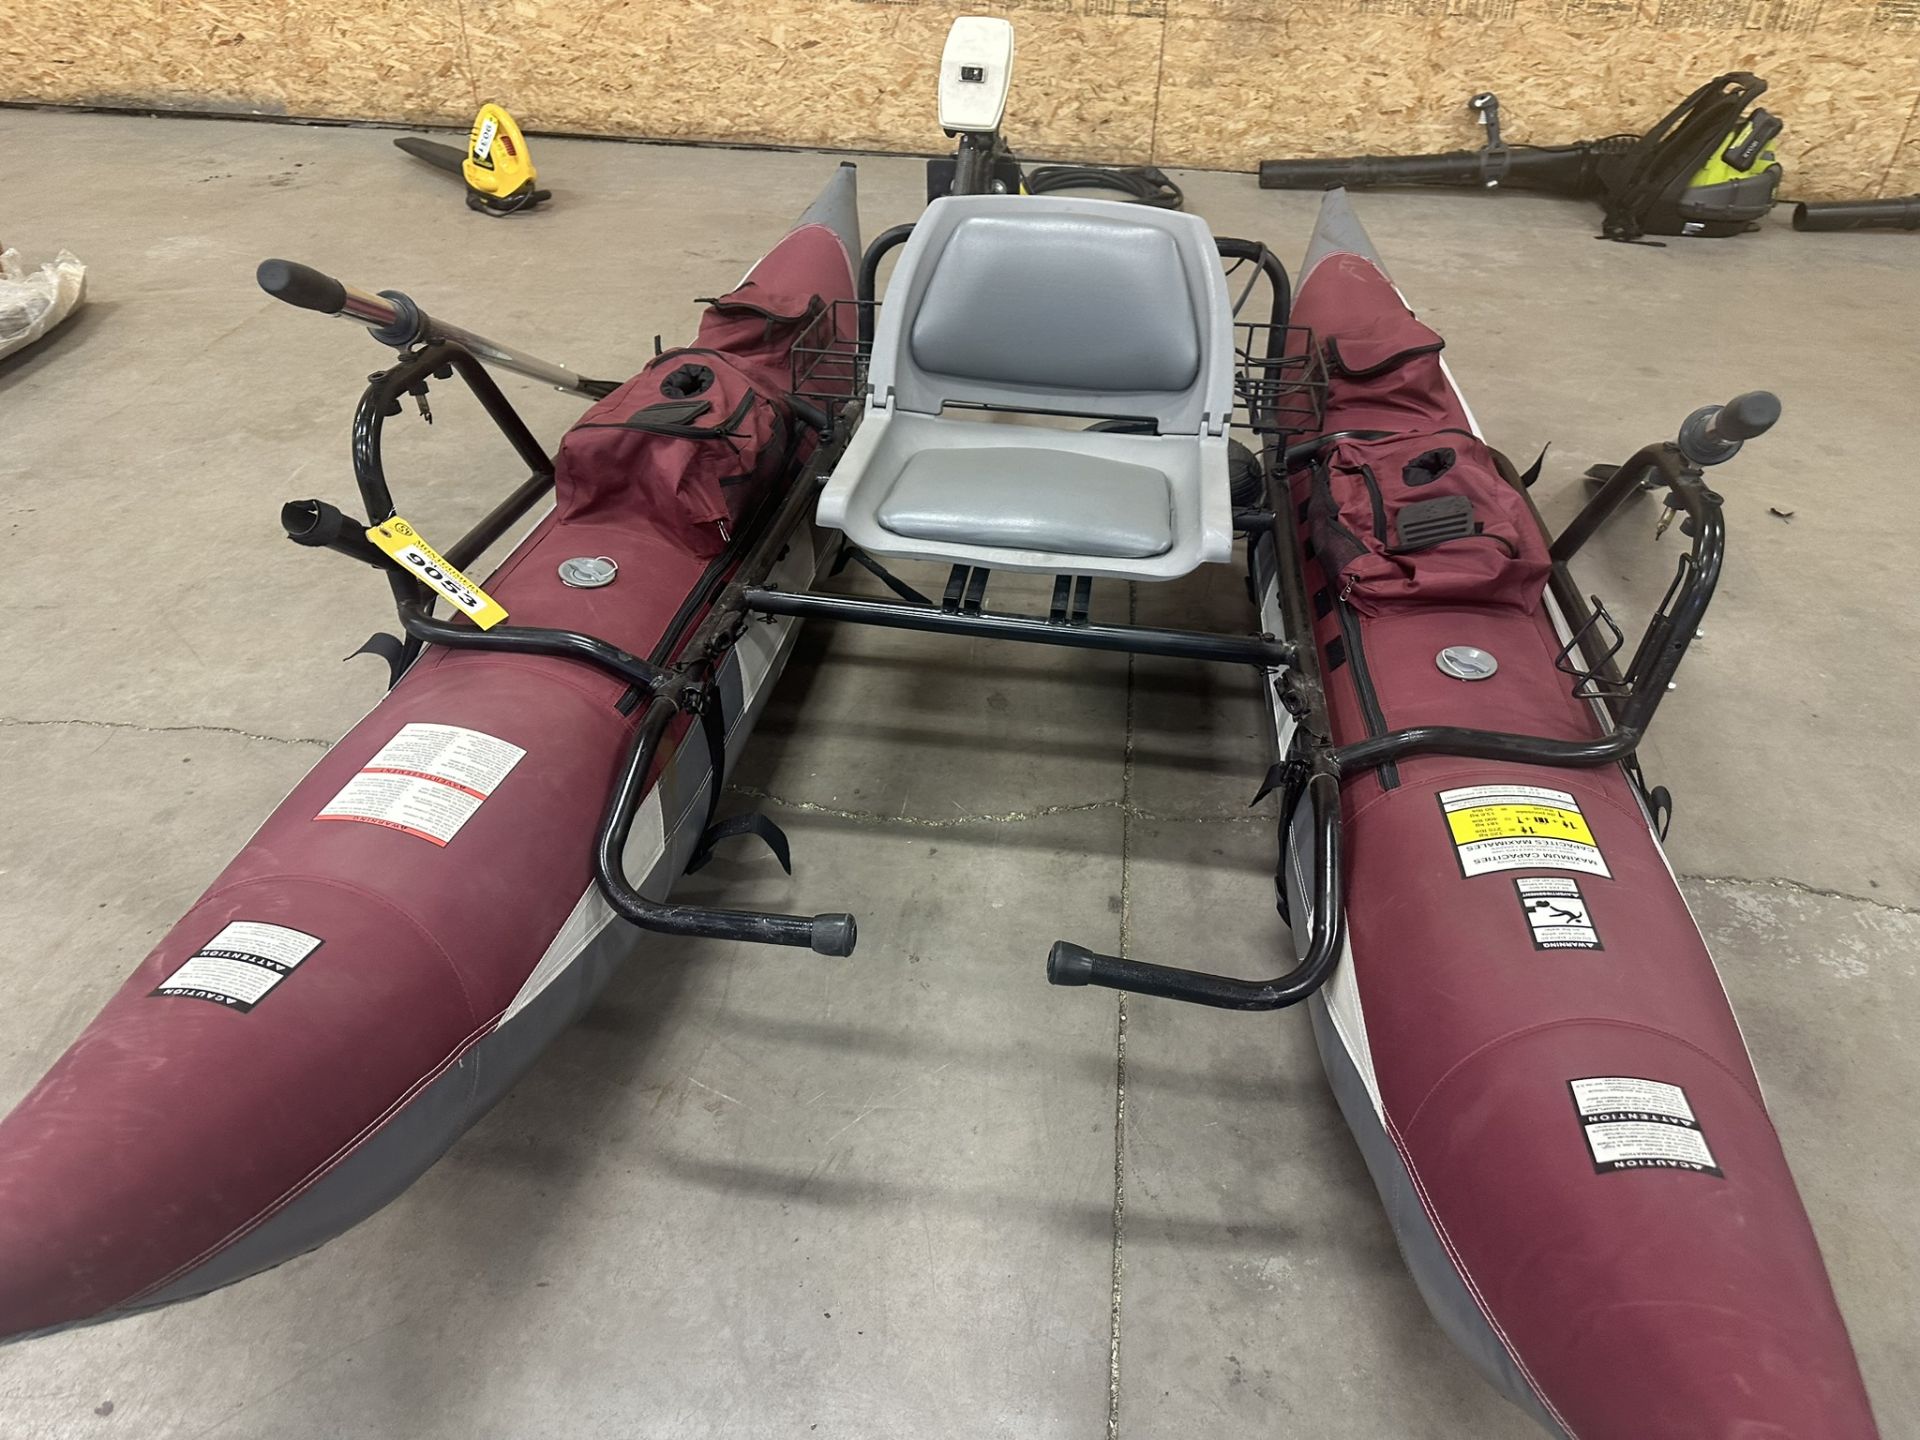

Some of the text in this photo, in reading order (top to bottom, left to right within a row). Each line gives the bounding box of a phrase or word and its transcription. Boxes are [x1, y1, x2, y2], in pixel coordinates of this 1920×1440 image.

[405, 552, 478, 608] 9053
[352, 814, 401, 829] WARNING
[1465, 839, 1532, 852] MAXIMALES
[1534, 839, 1595, 853] CAPACITÉS
[1472, 852, 1540, 865] CAPACITIES
[1542, 853, 1598, 866] MAXIMUM
[199, 949, 276, 967] ATTENTION
[162, 988, 226, 1001] CAUTION
[1587, 1112, 1679, 1123] ATTENTION
[1613, 1159, 1690, 1169] CAUTION
